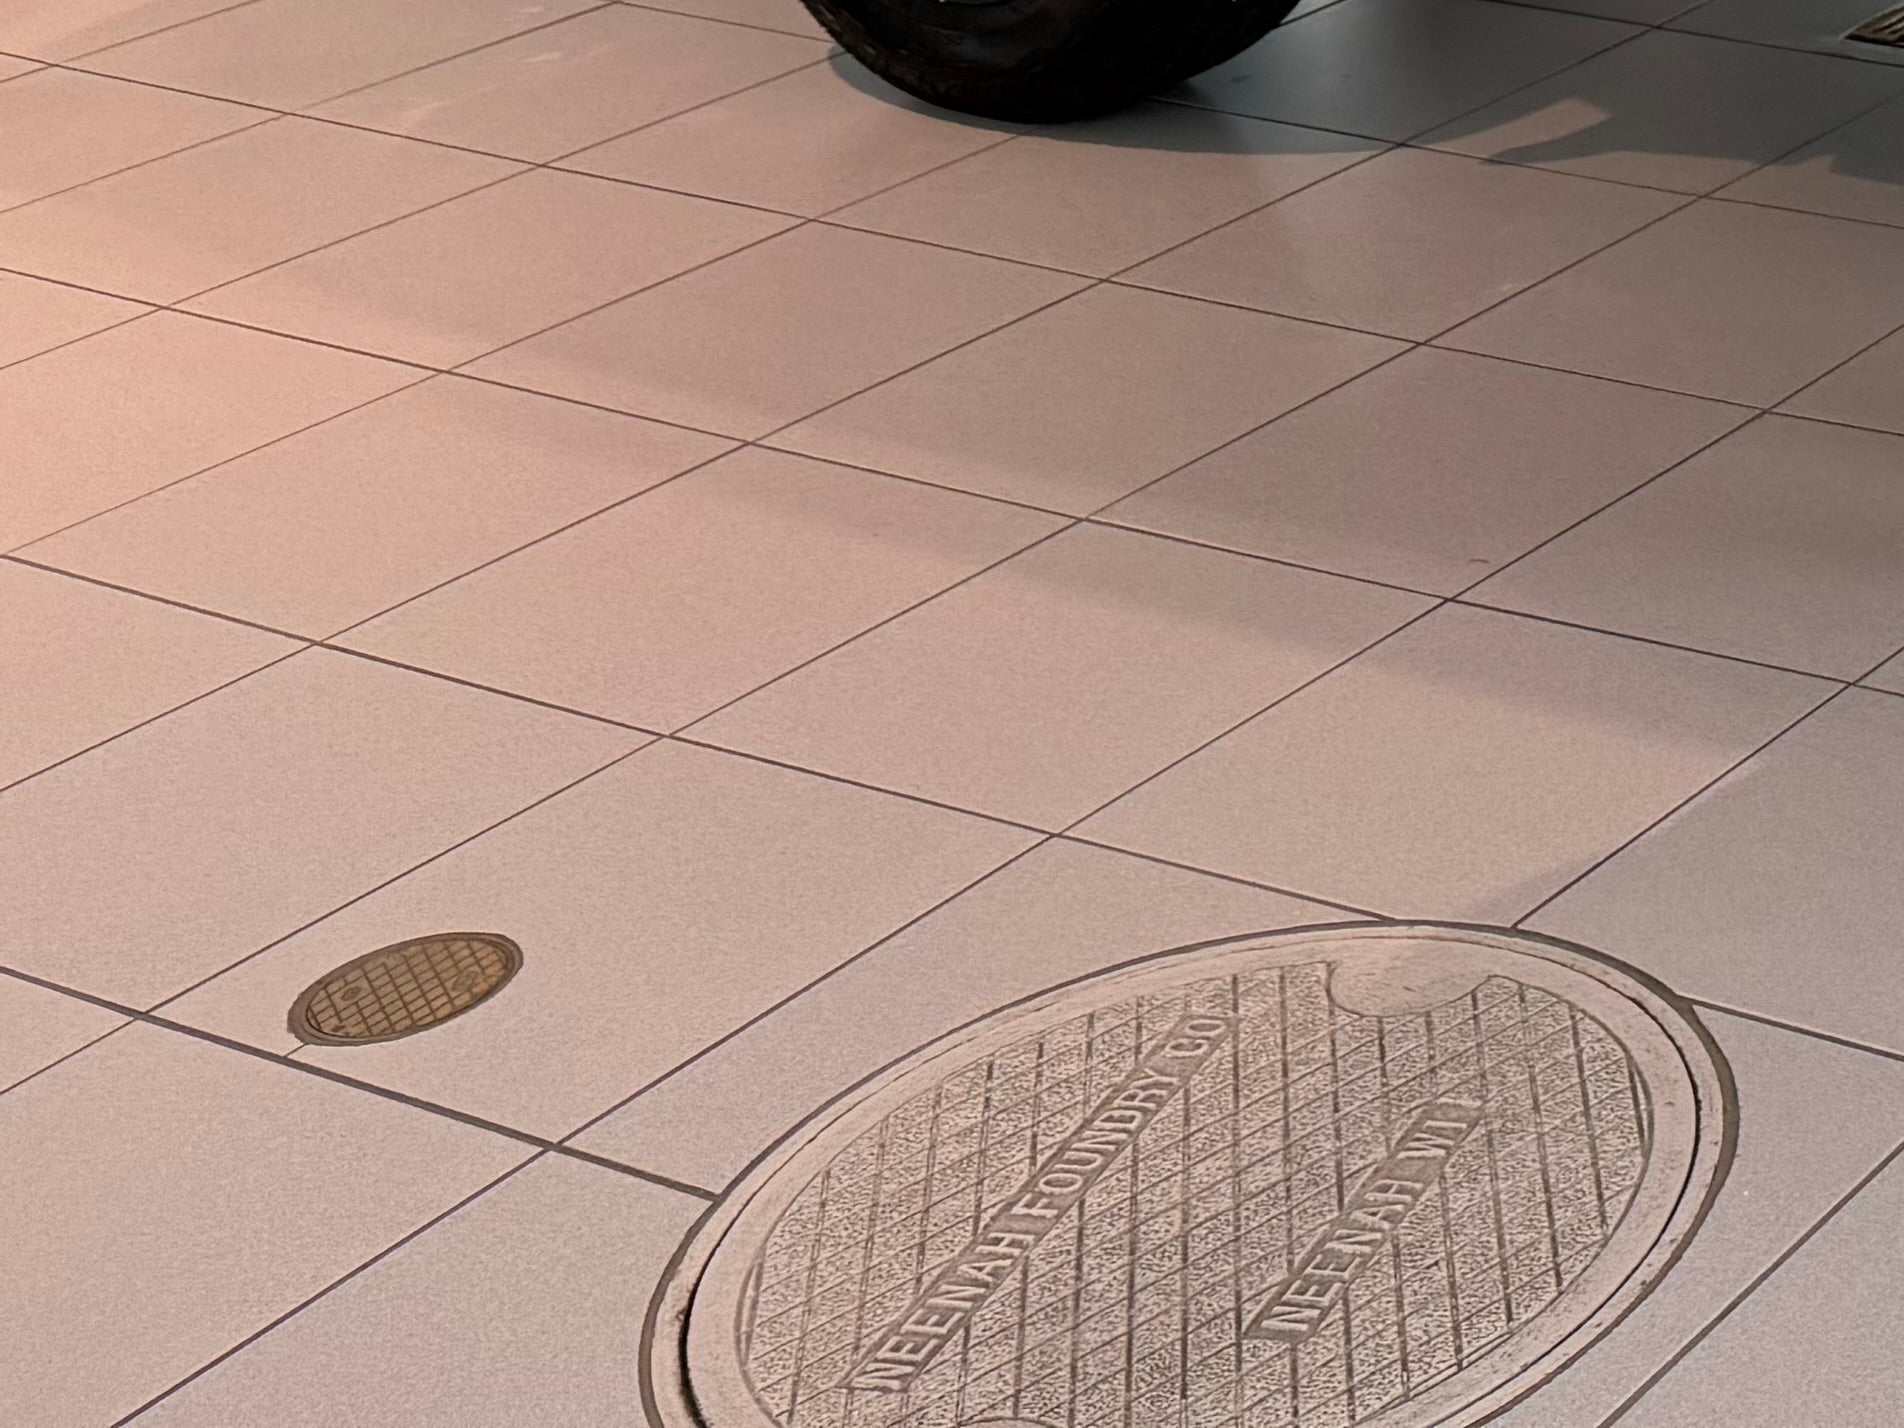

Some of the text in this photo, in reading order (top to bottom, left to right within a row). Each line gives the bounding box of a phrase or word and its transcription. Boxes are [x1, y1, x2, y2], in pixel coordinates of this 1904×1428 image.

[852, 1019, 1227, 1390] NEENAH FOUNDRY CO
[1259, 1119, 1467, 1332] NEENAH WI
